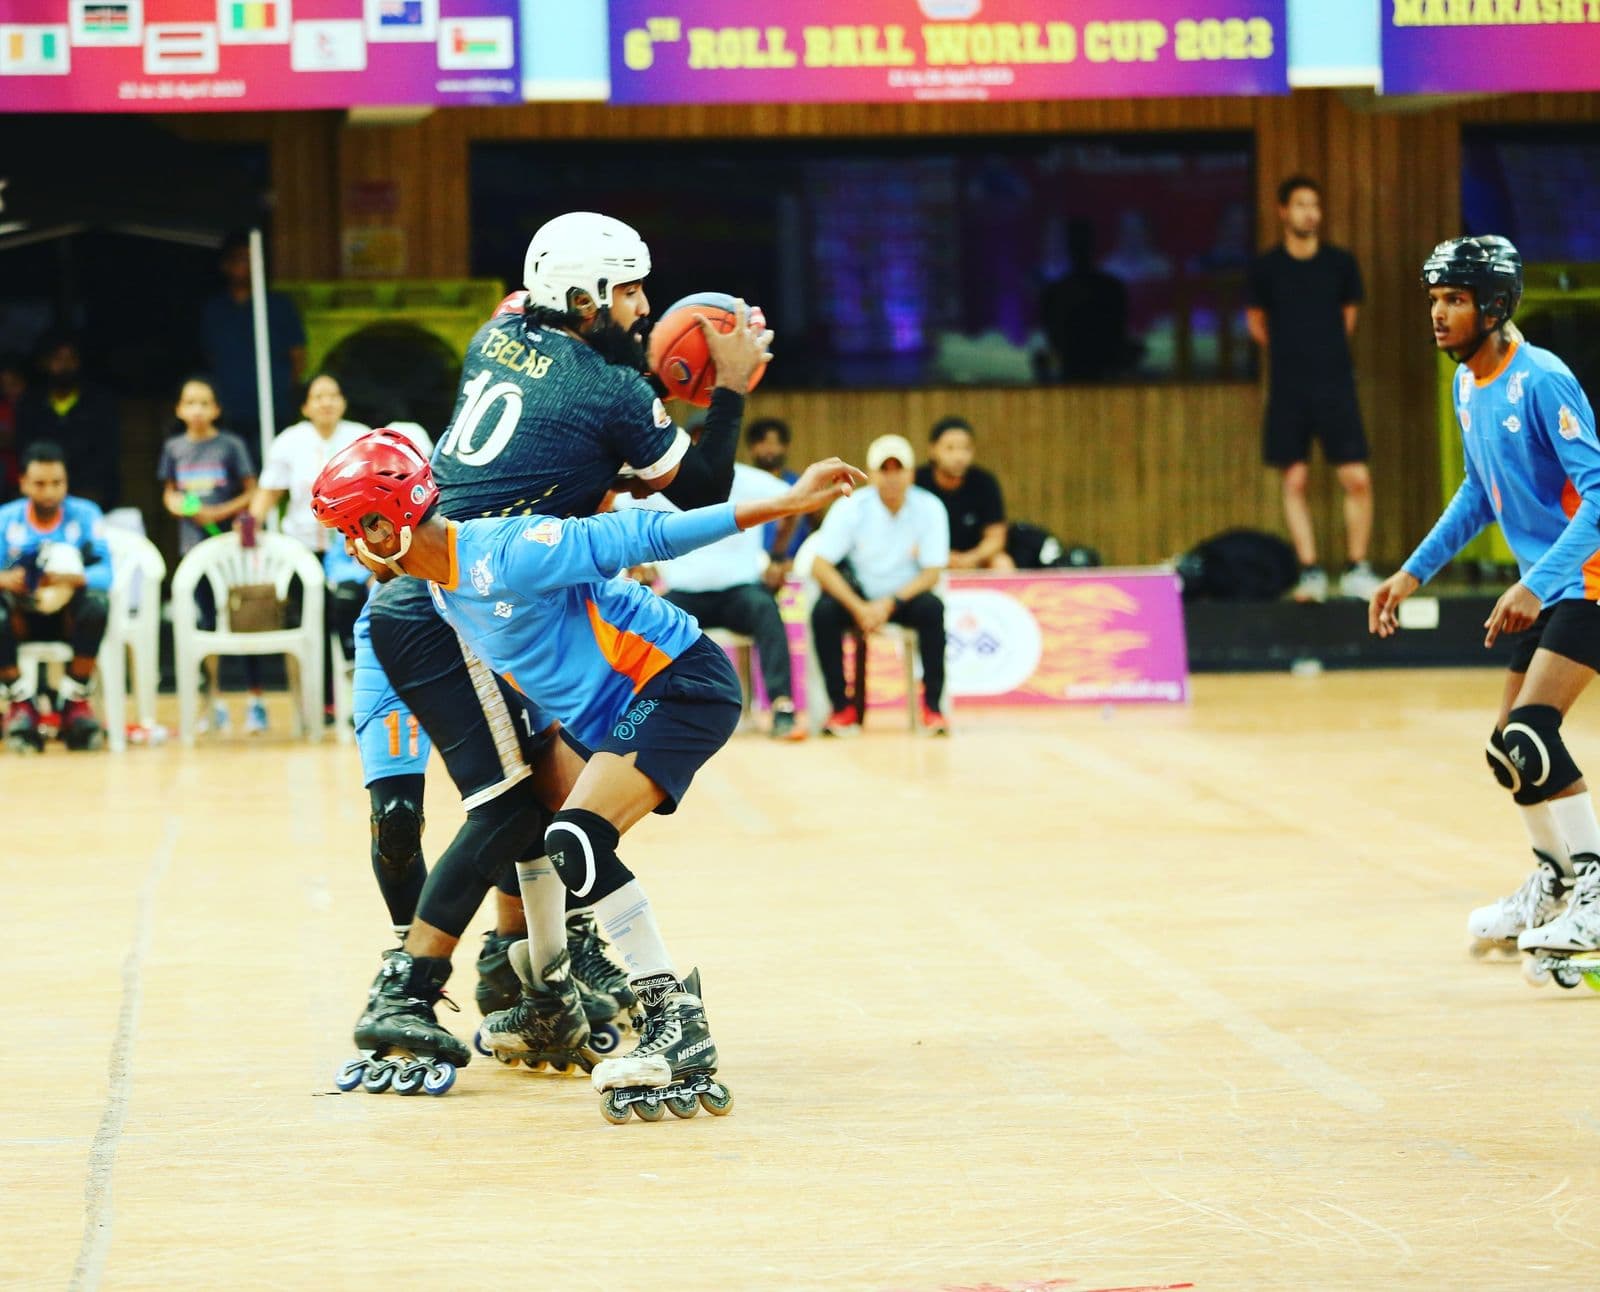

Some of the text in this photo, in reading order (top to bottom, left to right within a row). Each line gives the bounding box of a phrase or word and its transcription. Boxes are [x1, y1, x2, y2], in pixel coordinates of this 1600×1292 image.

[687, 27, 797, 69] ROLL
[803, 26, 915, 67] BALL
[922, 22, 1078, 66] WORLD
[1083, 20, 1167, 63] CUP
[1174, 18, 1274, 61] 2023
[481, 328, 553, 379] T3ELAB
[441, 370, 524, 467] 10
[383, 711, 419, 757] 11
[637, 976, 671, 986] MISSION
